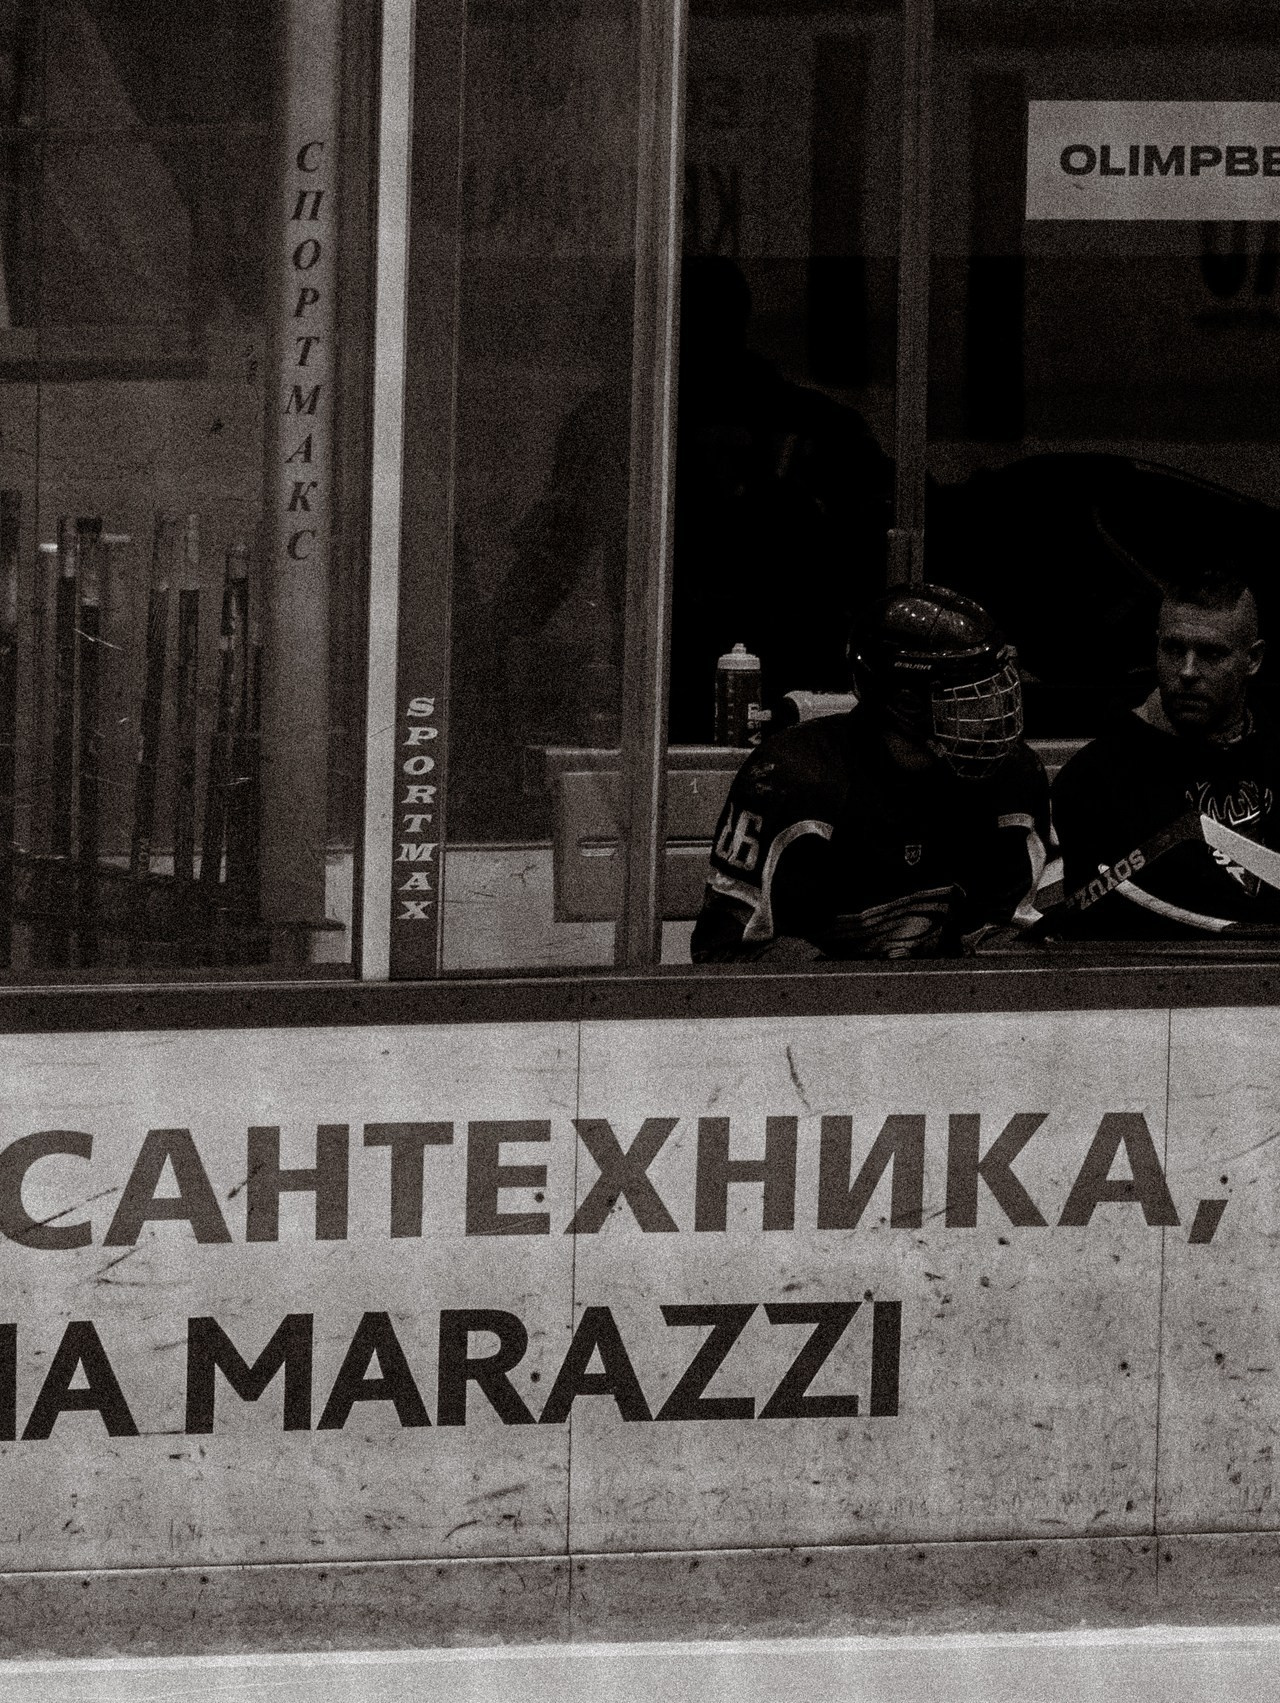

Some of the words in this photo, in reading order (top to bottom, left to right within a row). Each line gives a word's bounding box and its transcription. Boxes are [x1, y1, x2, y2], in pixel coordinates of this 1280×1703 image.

[283, 140, 325, 562] СПОРТМАКС
[395, 696, 439, 921] SPORTMAX
[0, 1111, 1230, 1251] САНТЕХНИКА,
[185, 1300, 902, 1436] MARAZZI
